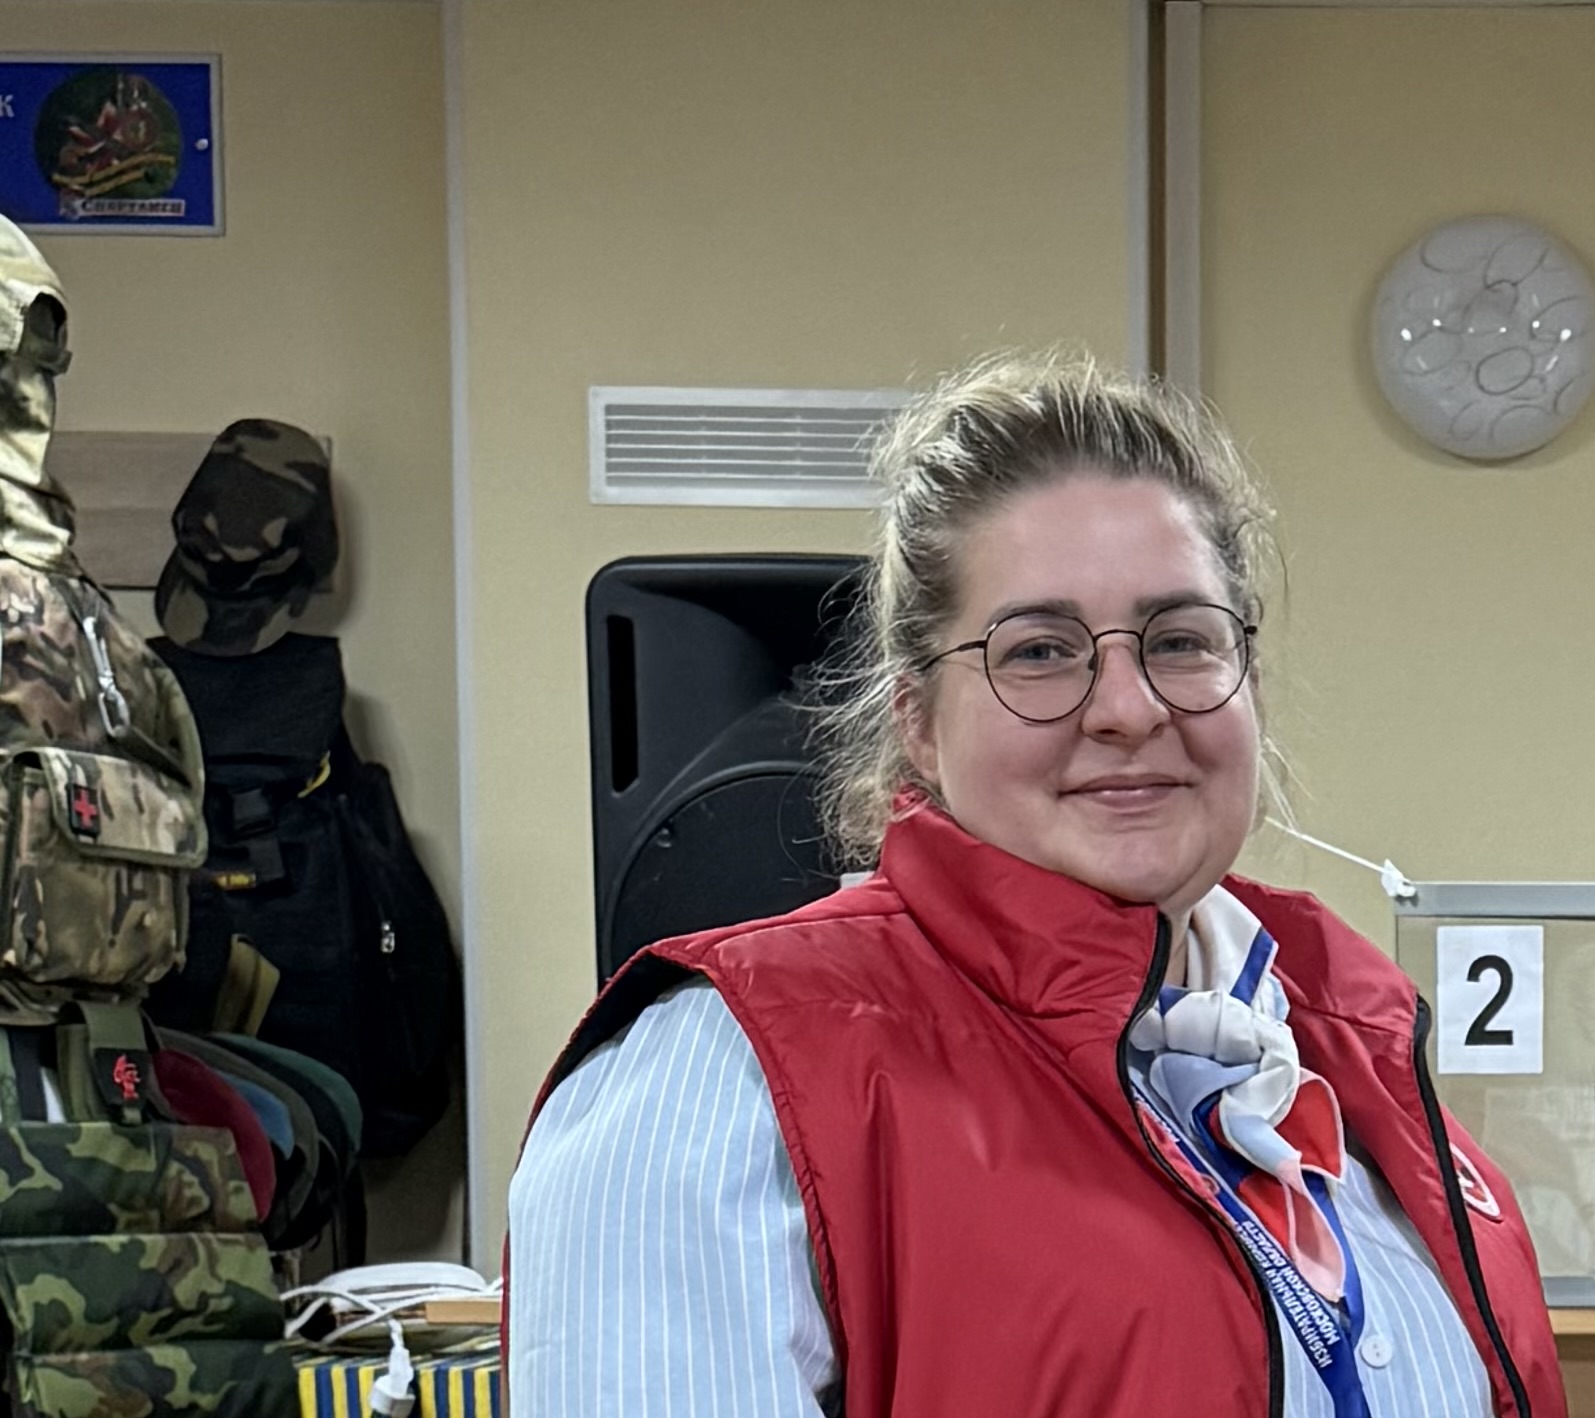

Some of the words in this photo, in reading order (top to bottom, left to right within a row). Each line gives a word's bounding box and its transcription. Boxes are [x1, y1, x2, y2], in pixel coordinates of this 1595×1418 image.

[1464, 954, 1515, 1047] 2
[1264, 1266, 1334, 1370] ИЗБИРАТЕЛЬНАЯ
[1279, 1264, 1341, 1347] МОСКОВСКОЙ
